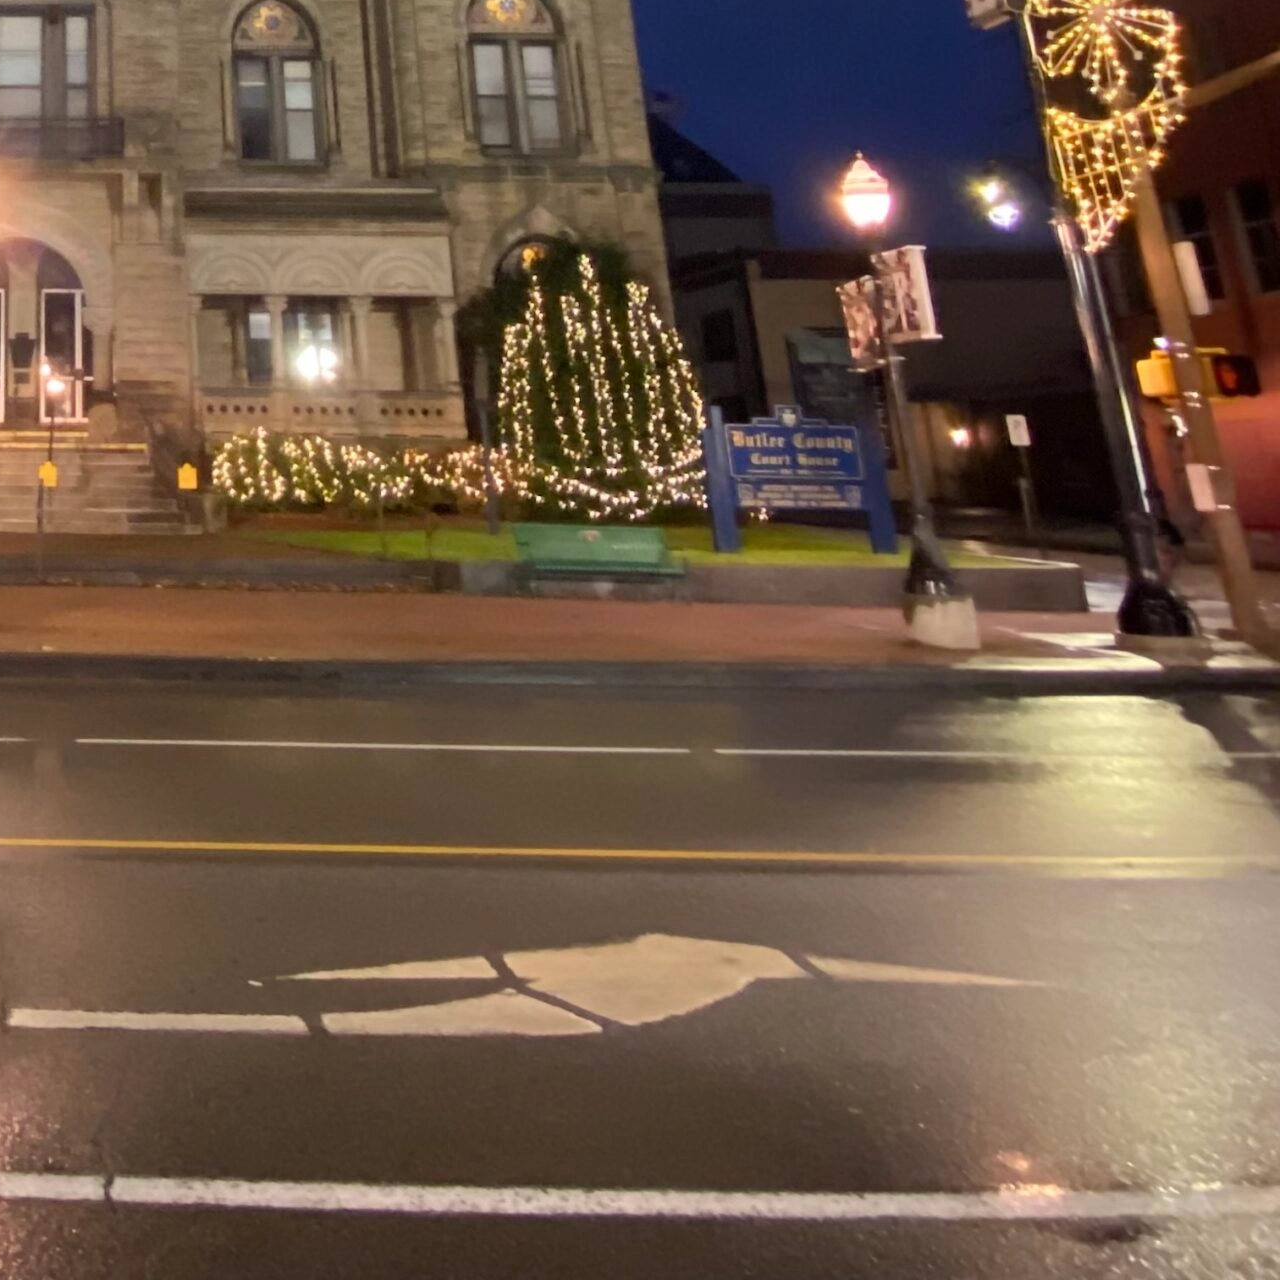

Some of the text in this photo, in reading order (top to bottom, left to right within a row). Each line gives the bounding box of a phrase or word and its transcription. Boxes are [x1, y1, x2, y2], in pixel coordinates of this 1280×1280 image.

[730, 430, 854, 453] Butler County
[750, 452, 839, 466] Court House
